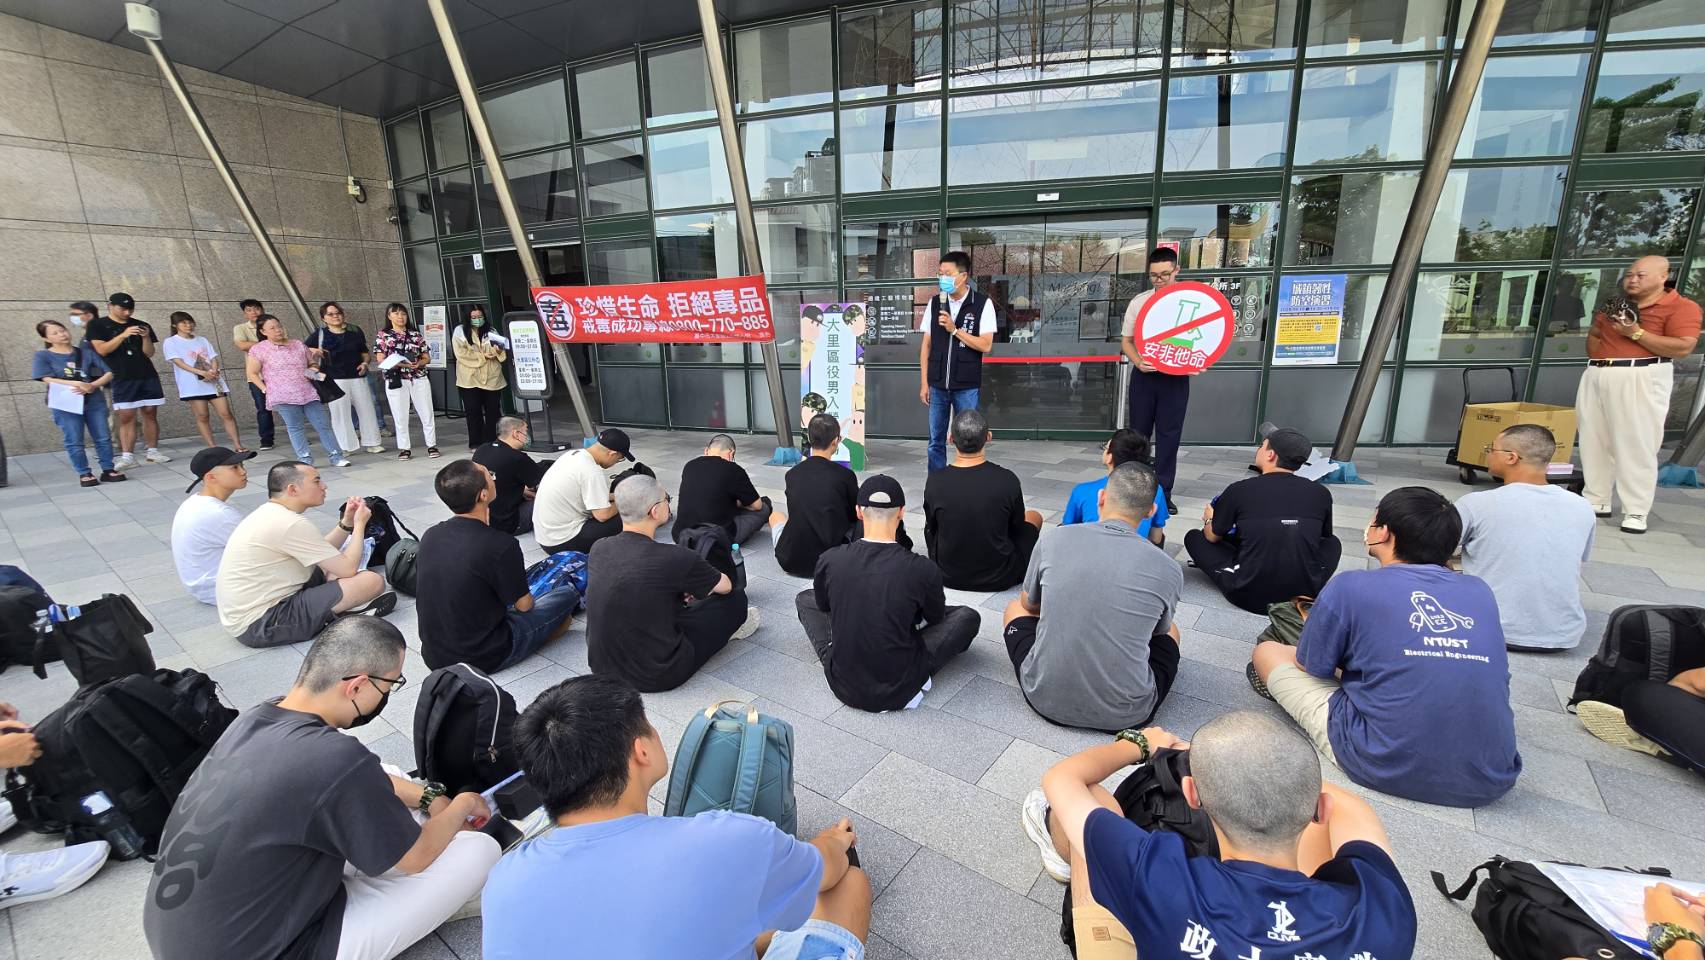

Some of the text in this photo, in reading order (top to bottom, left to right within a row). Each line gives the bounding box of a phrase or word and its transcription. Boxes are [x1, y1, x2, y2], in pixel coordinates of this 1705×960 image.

[1230, 282, 1241, 290] 3F
[575, 286, 765, 319] 珍惜生命 拒絕毒品
[540, 299, 570, 332] 毒
[1142, 342, 1208, 369] 安非他命
[1423, 636, 1469, 649] NTUST
[1403, 649, 1490, 663] Electrical Engineering
